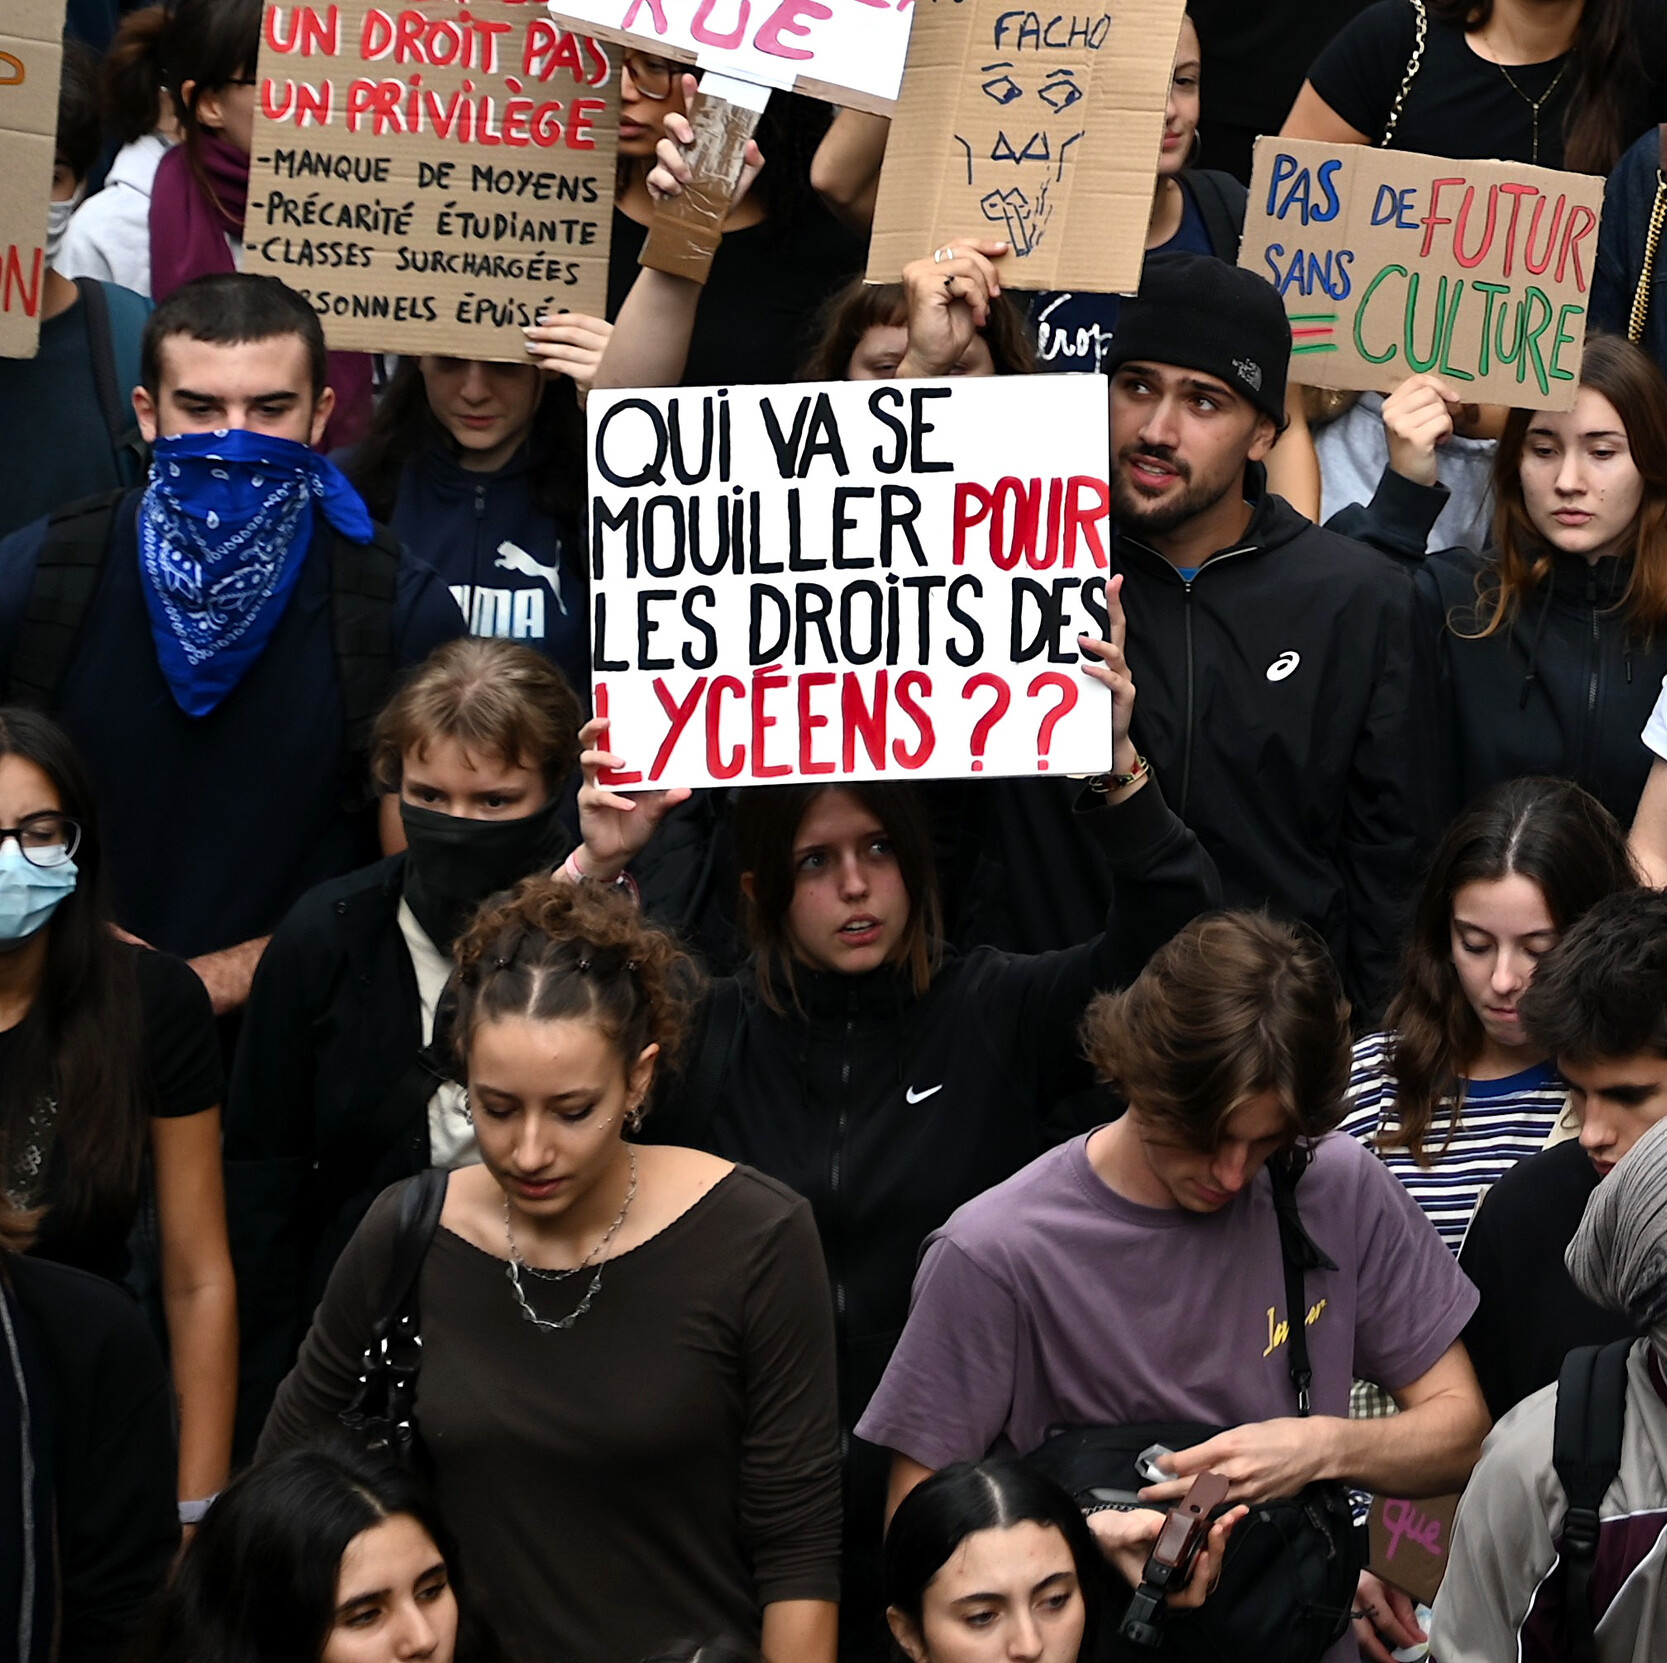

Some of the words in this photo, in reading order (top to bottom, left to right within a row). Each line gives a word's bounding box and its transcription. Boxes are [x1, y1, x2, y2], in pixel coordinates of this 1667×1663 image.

[265, 3, 341, 58] UN
[360, 8, 513, 75] DROIT
[522, 19, 610, 89] PAS
[994, 10, 1112, 52] FACHO
[260, 77, 333, 129] UN
[418, 162, 455, 190] DE
[471, 164, 599, 204] MOYENS
[436, 200, 598, 246] ÉTUDIANTE
[1266, 153, 1343, 226] PAS
[1370, 184, 1420, 229] DE
[1419, 177, 1597, 293] FUTUR
[396, 246, 580, 286] SURCHARGÉES
[1264, 242, 1354, 301] SANS
[1353, 264, 1585, 396] CULTURE
[595, 388, 731, 487] QUI
[759, 392, 850, 479] VA
[869, 387, 955, 474] SE
[592, 484, 929, 580] MOUILLER
[951, 475, 1110, 571] POUR
[593, 586, 718, 672] LES
[748, 572, 983, 667] DROITS
[1009, 576, 1107, 664] DES
[593, 663, 935, 786] LYCÉENS
